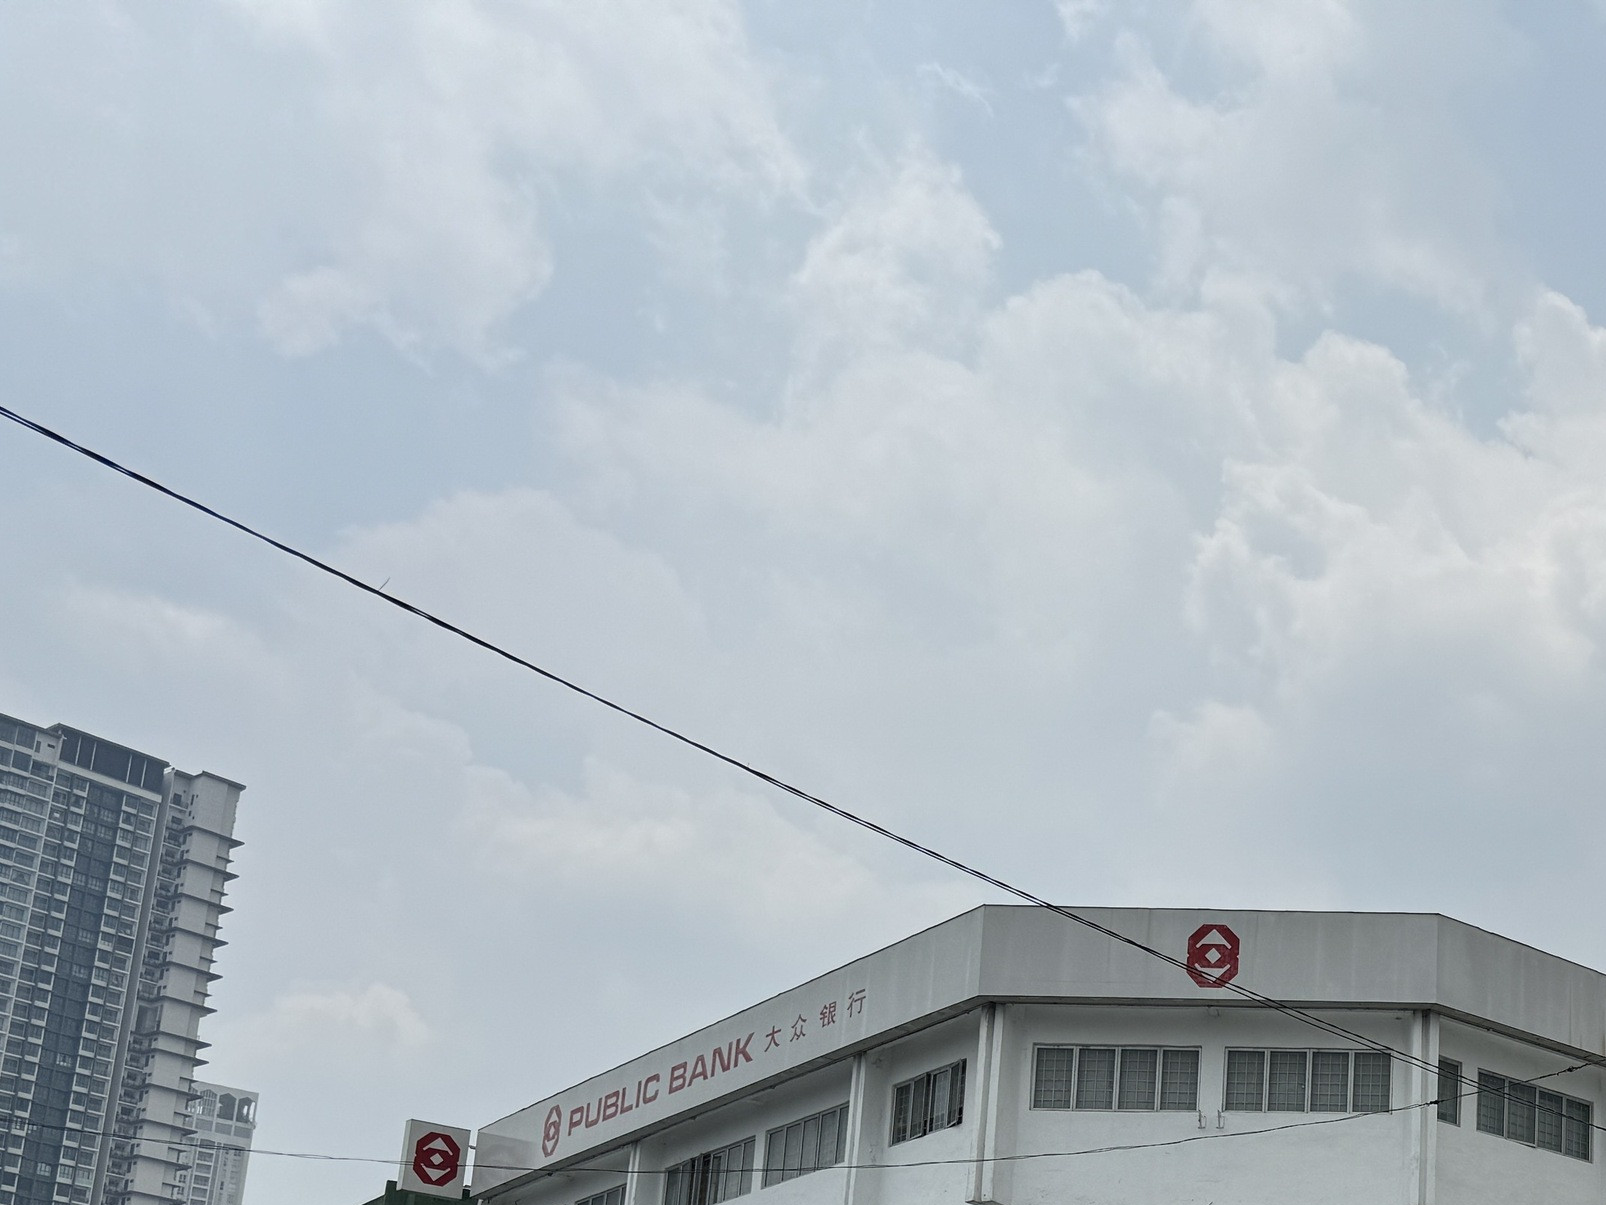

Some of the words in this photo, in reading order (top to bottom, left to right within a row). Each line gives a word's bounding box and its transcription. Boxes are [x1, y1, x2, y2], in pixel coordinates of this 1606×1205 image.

[764, 988, 867, 1052] 大众银行
[568, 1073, 660, 1136] PUBLIC
[668, 1031, 755, 1094] BANK
